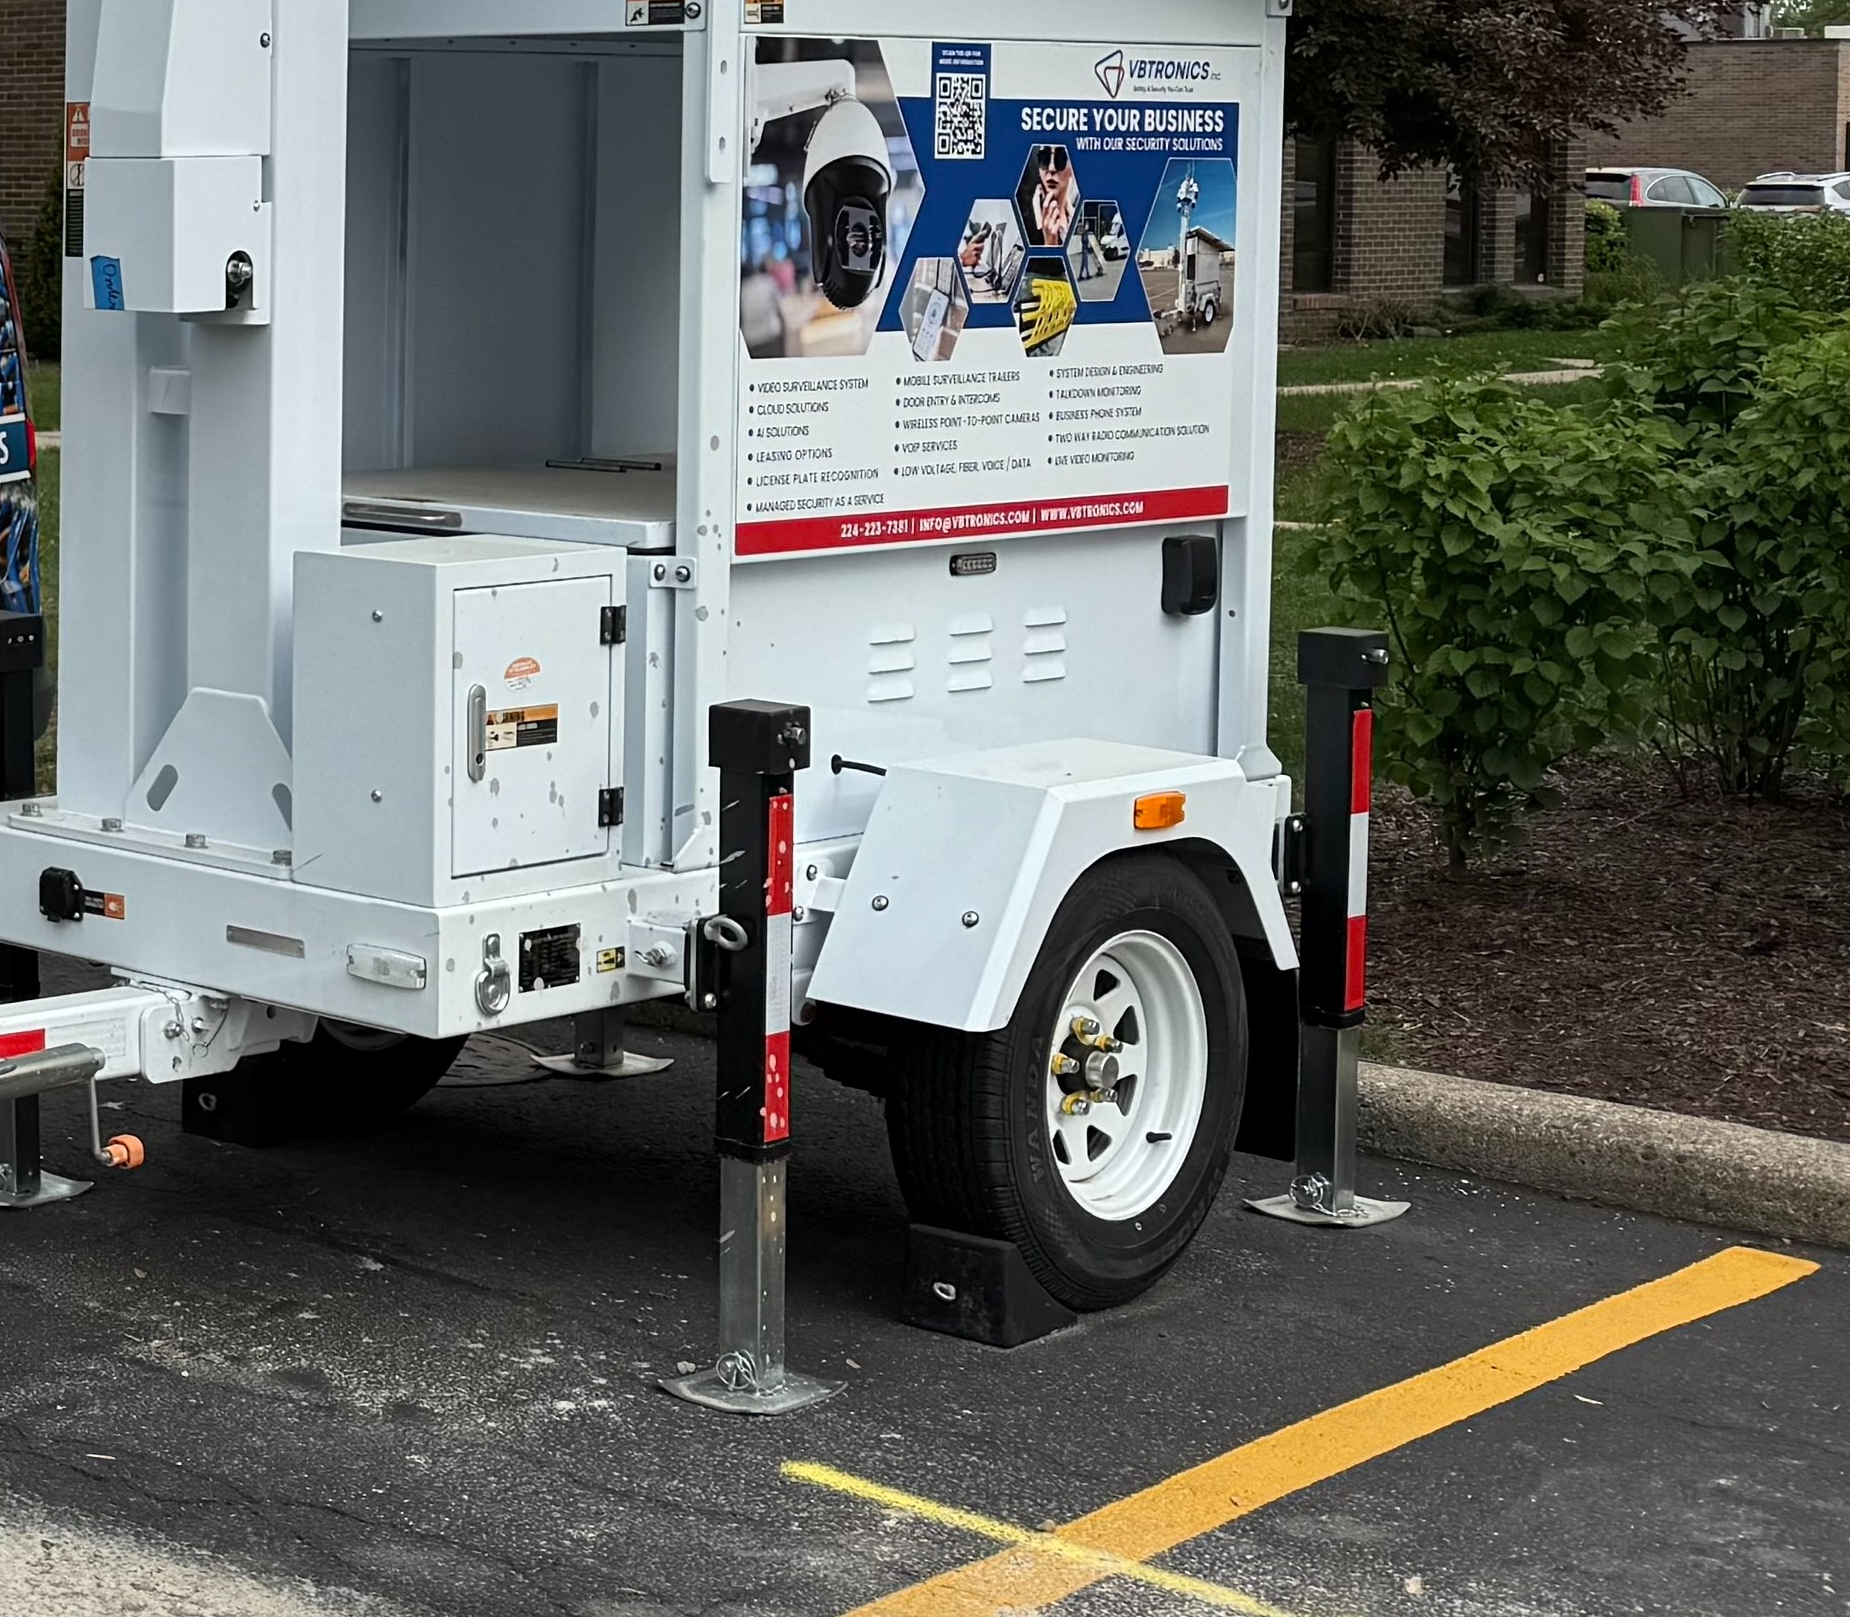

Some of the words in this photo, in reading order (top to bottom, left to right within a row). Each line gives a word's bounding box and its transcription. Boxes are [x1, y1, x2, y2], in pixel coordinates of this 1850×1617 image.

[1128, 58, 1210, 81] VBTRONICS
[1021, 107, 1088, 131] SECURE
[1092, 108, 1140, 132] YOUR
[1144, 109, 1224, 133] BUSINESS
[1076, 137, 1101, 151] WITH
[1103, 137, 1124, 151] OUR
[1126, 137, 1170, 151] SECURITY
[1172, 138, 1223, 151] SOLUTIONS
[919, 509, 1029, 533] INFO@VBTRONICS.COM
